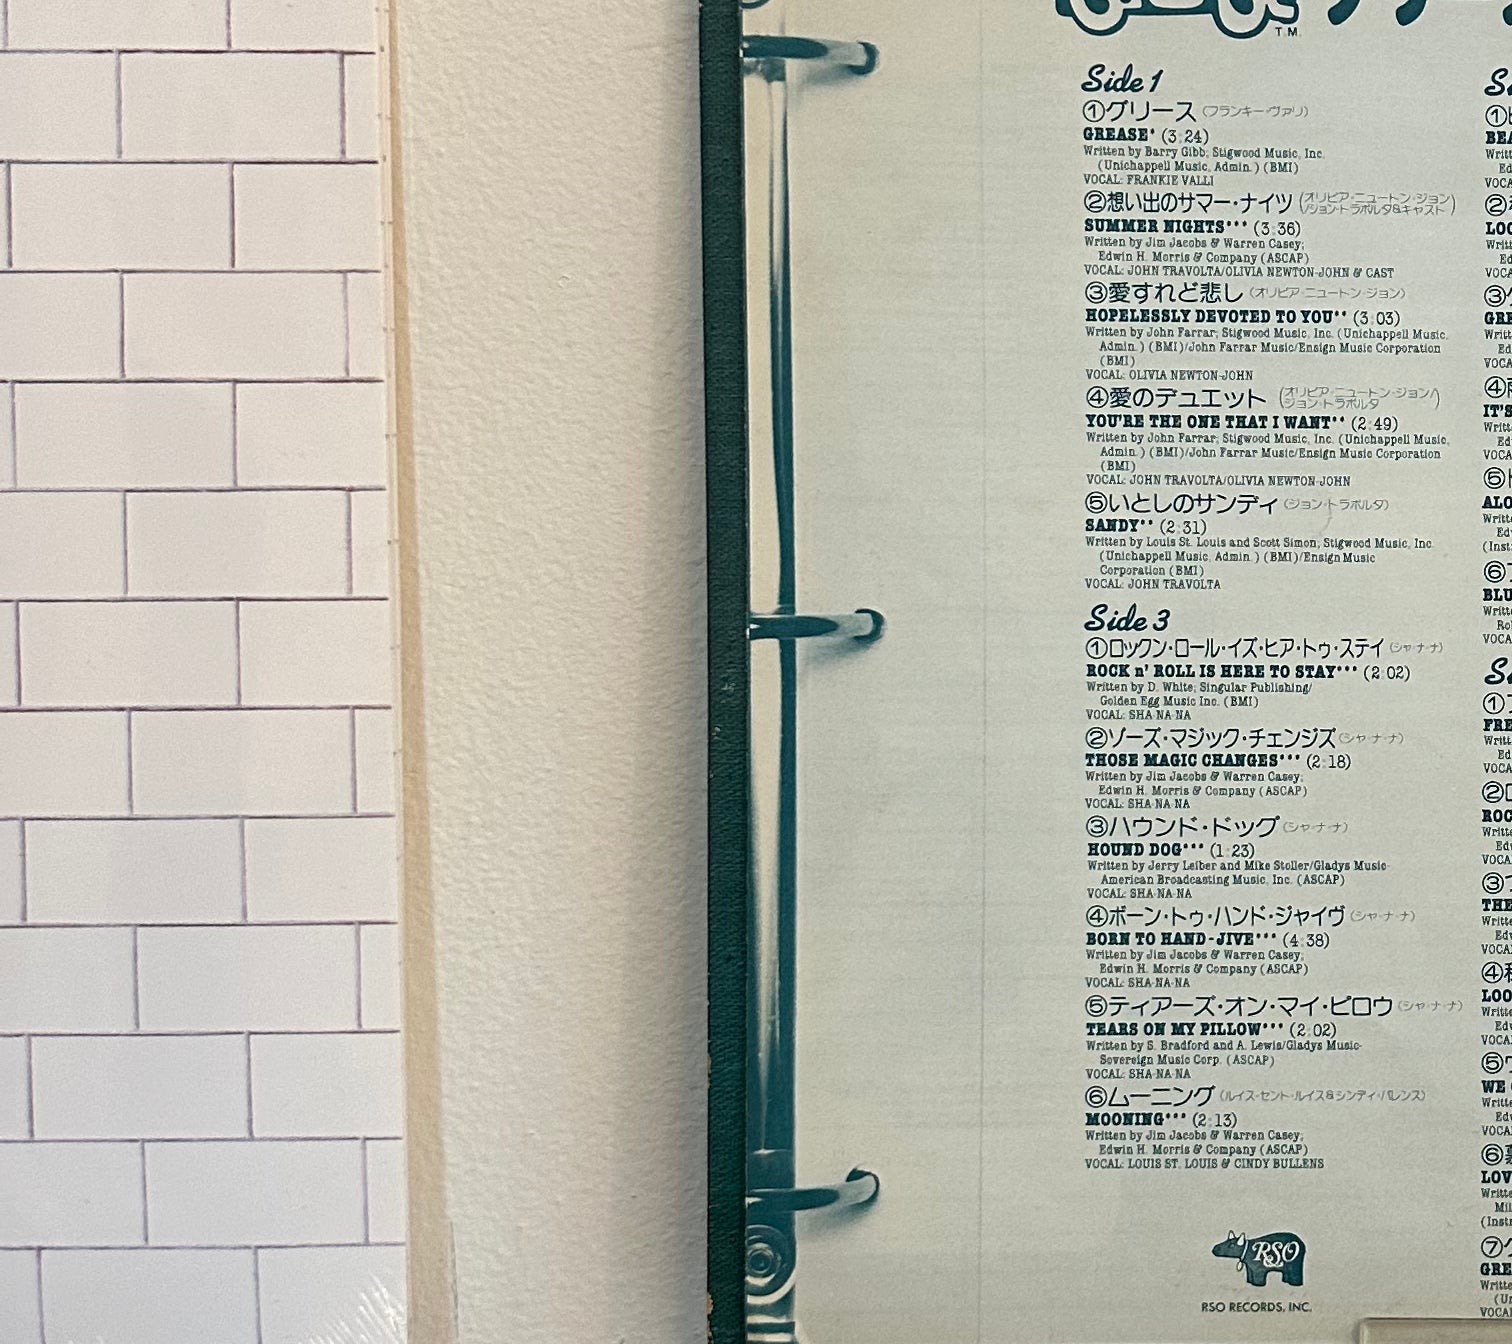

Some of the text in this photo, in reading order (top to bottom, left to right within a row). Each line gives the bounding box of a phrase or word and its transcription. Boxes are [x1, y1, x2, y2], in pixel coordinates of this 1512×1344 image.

[1081, 63, 1164, 93] Side 1
[1127, 174, 1178, 186] FRANKIE
[1181, 174, 1214, 186] VALLI
[1084, 219, 1159, 233] SUMMER
[1085, 236, 1128, 250] Written
[1130, 236, 1142, 250] by
[1145, 236, 1166, 250] Jim
[1169, 236, 1207, 250] Jacobs
[1211, 236, 1220, 250] &
[1223, 236, 1265, 250] Warren
[1085, 309, 1191, 324] HOPELESSLY
[1196, 309, 1270, 324] DEVOTED
[1276, 309, 1296, 324] TO
[1129, 369, 1167, 381] OLIVIA
[1483, 404, 1512, 418] IT'S
[1086, 415, 1145, 429] YOU'RE
[1150, 415, 1182, 429] THE
[1187, 415, 1220, 429] ONE
[1225, 415, 1270, 429] THAT
[1273, 415, 1279, 429] I
[1128, 579, 1159, 590] JOHN
[1163, 579, 1221, 590] TRAVOLTA
[1084, 603, 1171, 631] Side 3
[1085, 754, 1138, 767] THOSE
[1144, 754, 1197, 767] MAGIC
[1086, 1023, 1138, 1036] TEARS
[1144, 1023, 1166, 1036] ON
[1171, 1023, 1196, 1036] MY
[1481, 1080, 1506, 1093] WE
[1251, 1240, 1301, 1269] RSO
[1201, 1301, 1226, 1313] RSO
